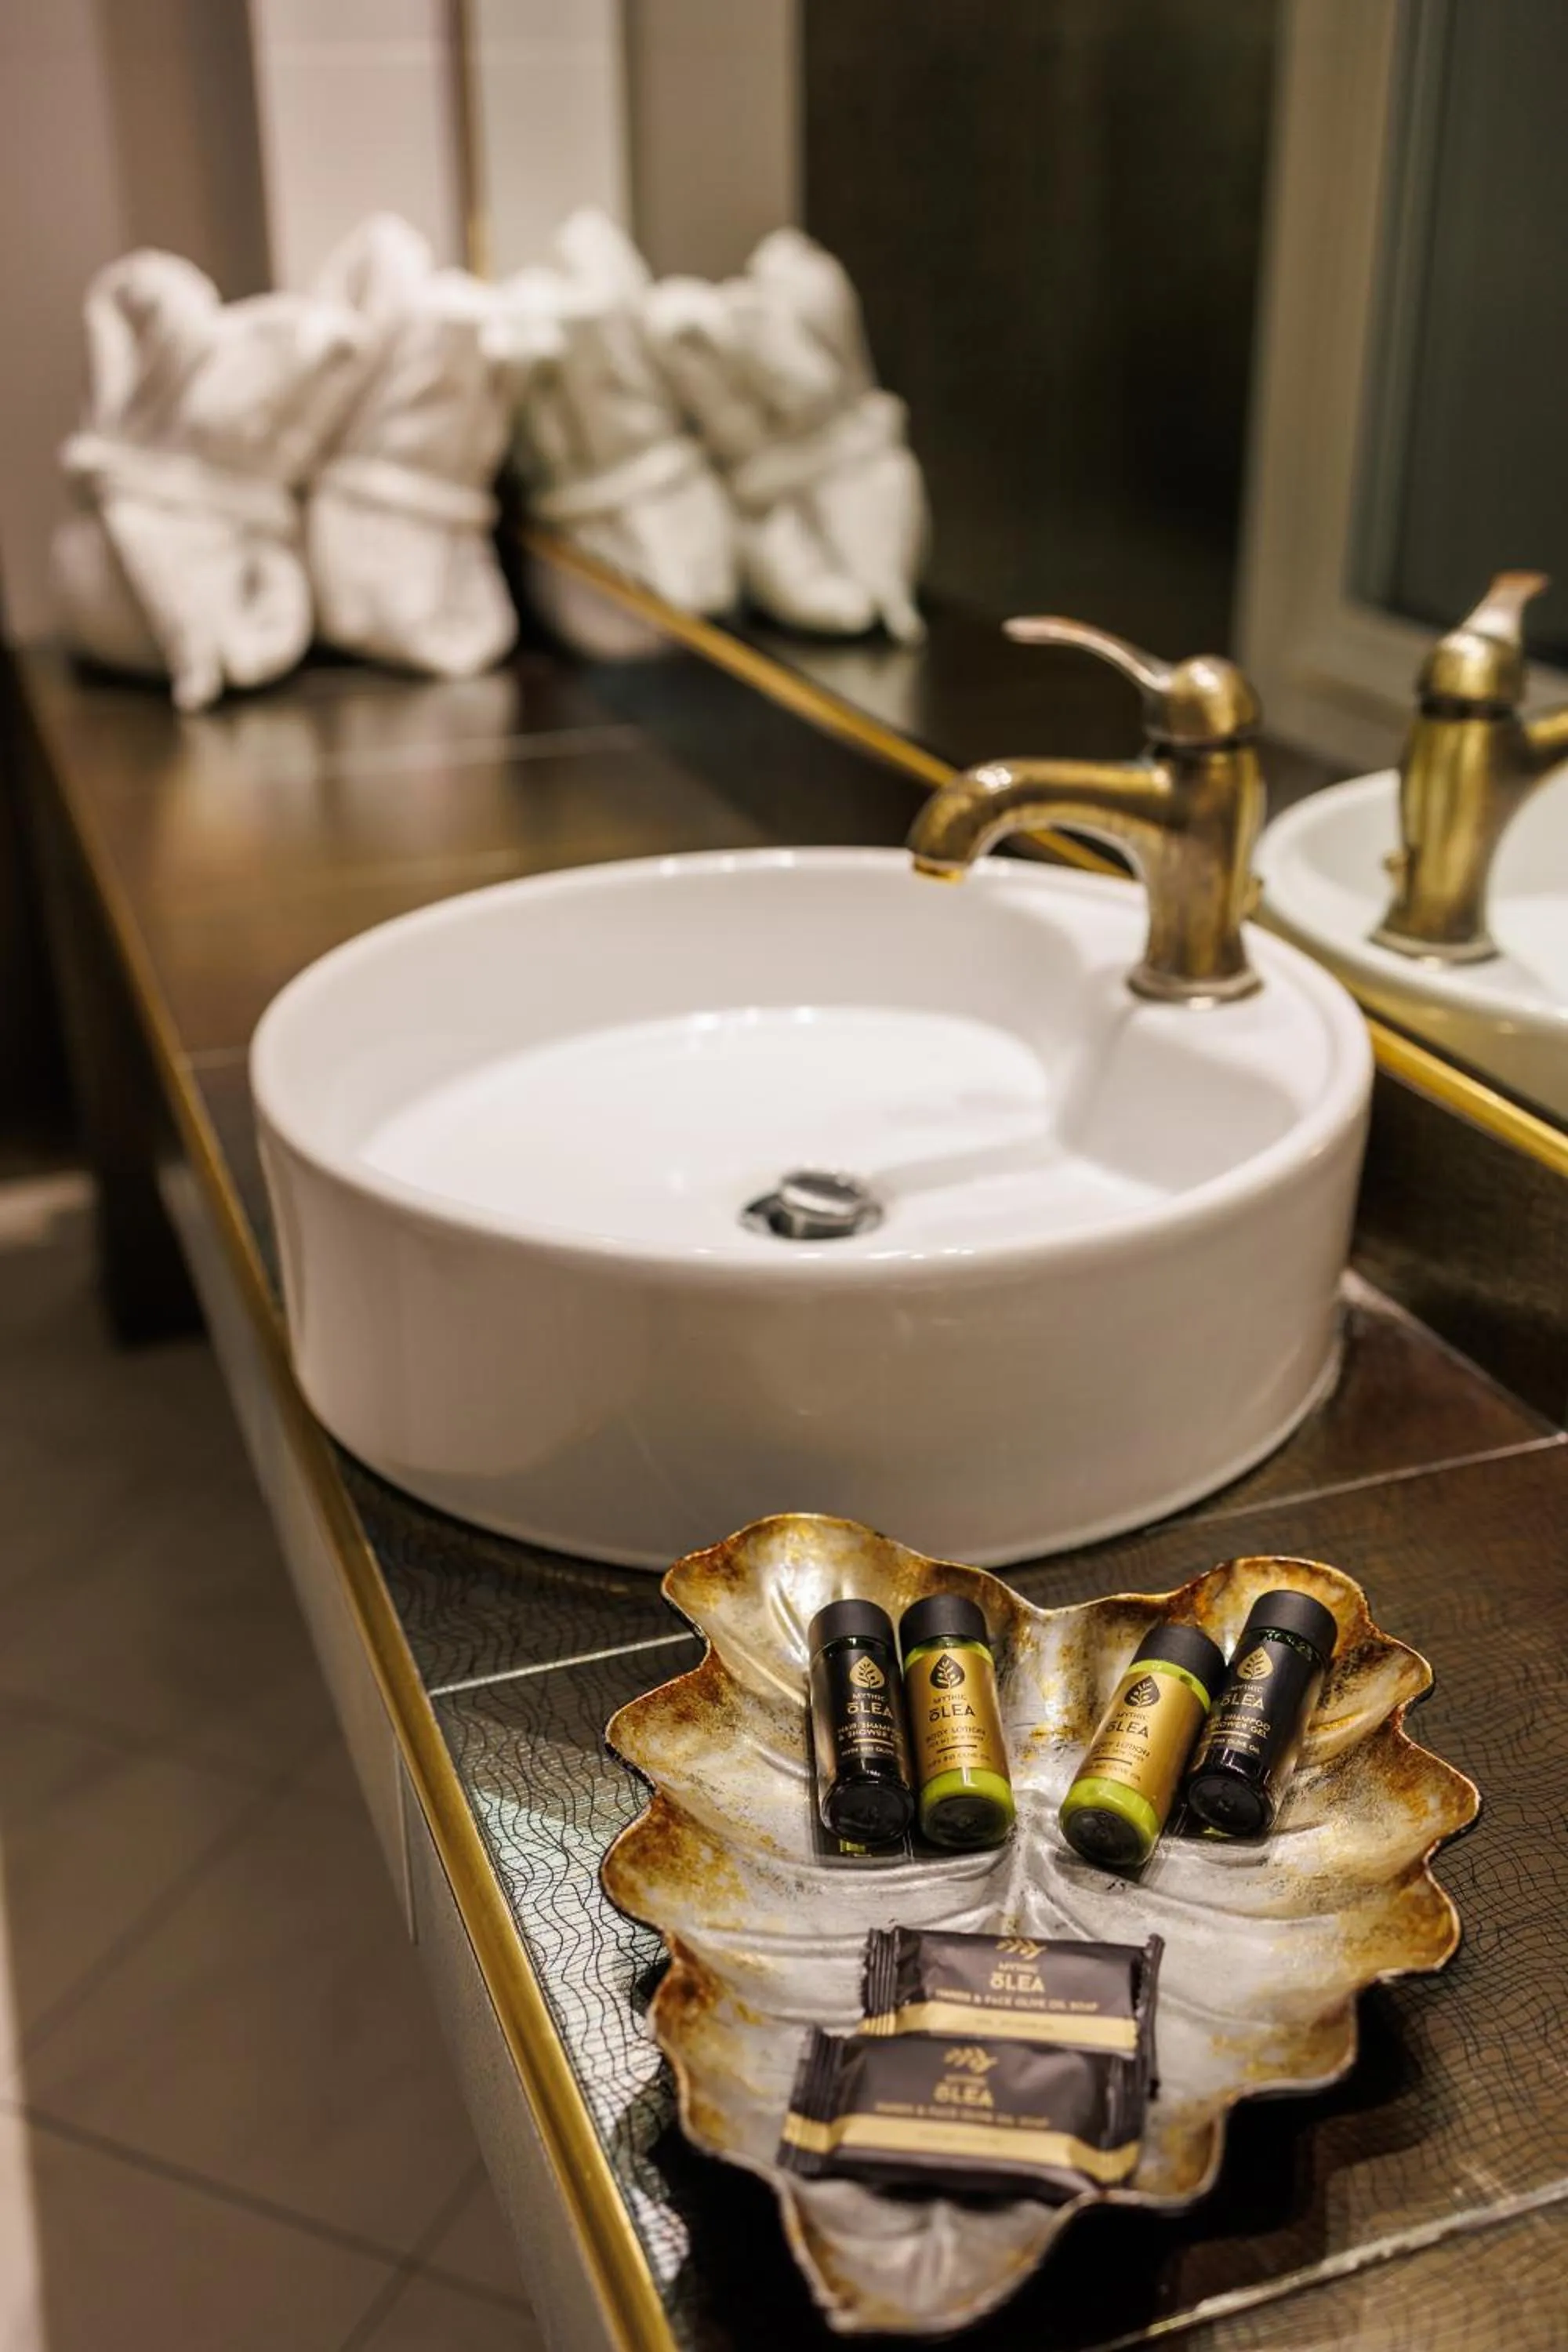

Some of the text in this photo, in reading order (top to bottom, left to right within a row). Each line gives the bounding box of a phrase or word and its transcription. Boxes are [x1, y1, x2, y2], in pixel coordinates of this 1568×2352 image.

[852, 1692, 888, 1702] MYTHIC
[932, 1693, 967, 1704] MYTHIC
[951, 1726, 986, 1737] LOTION
